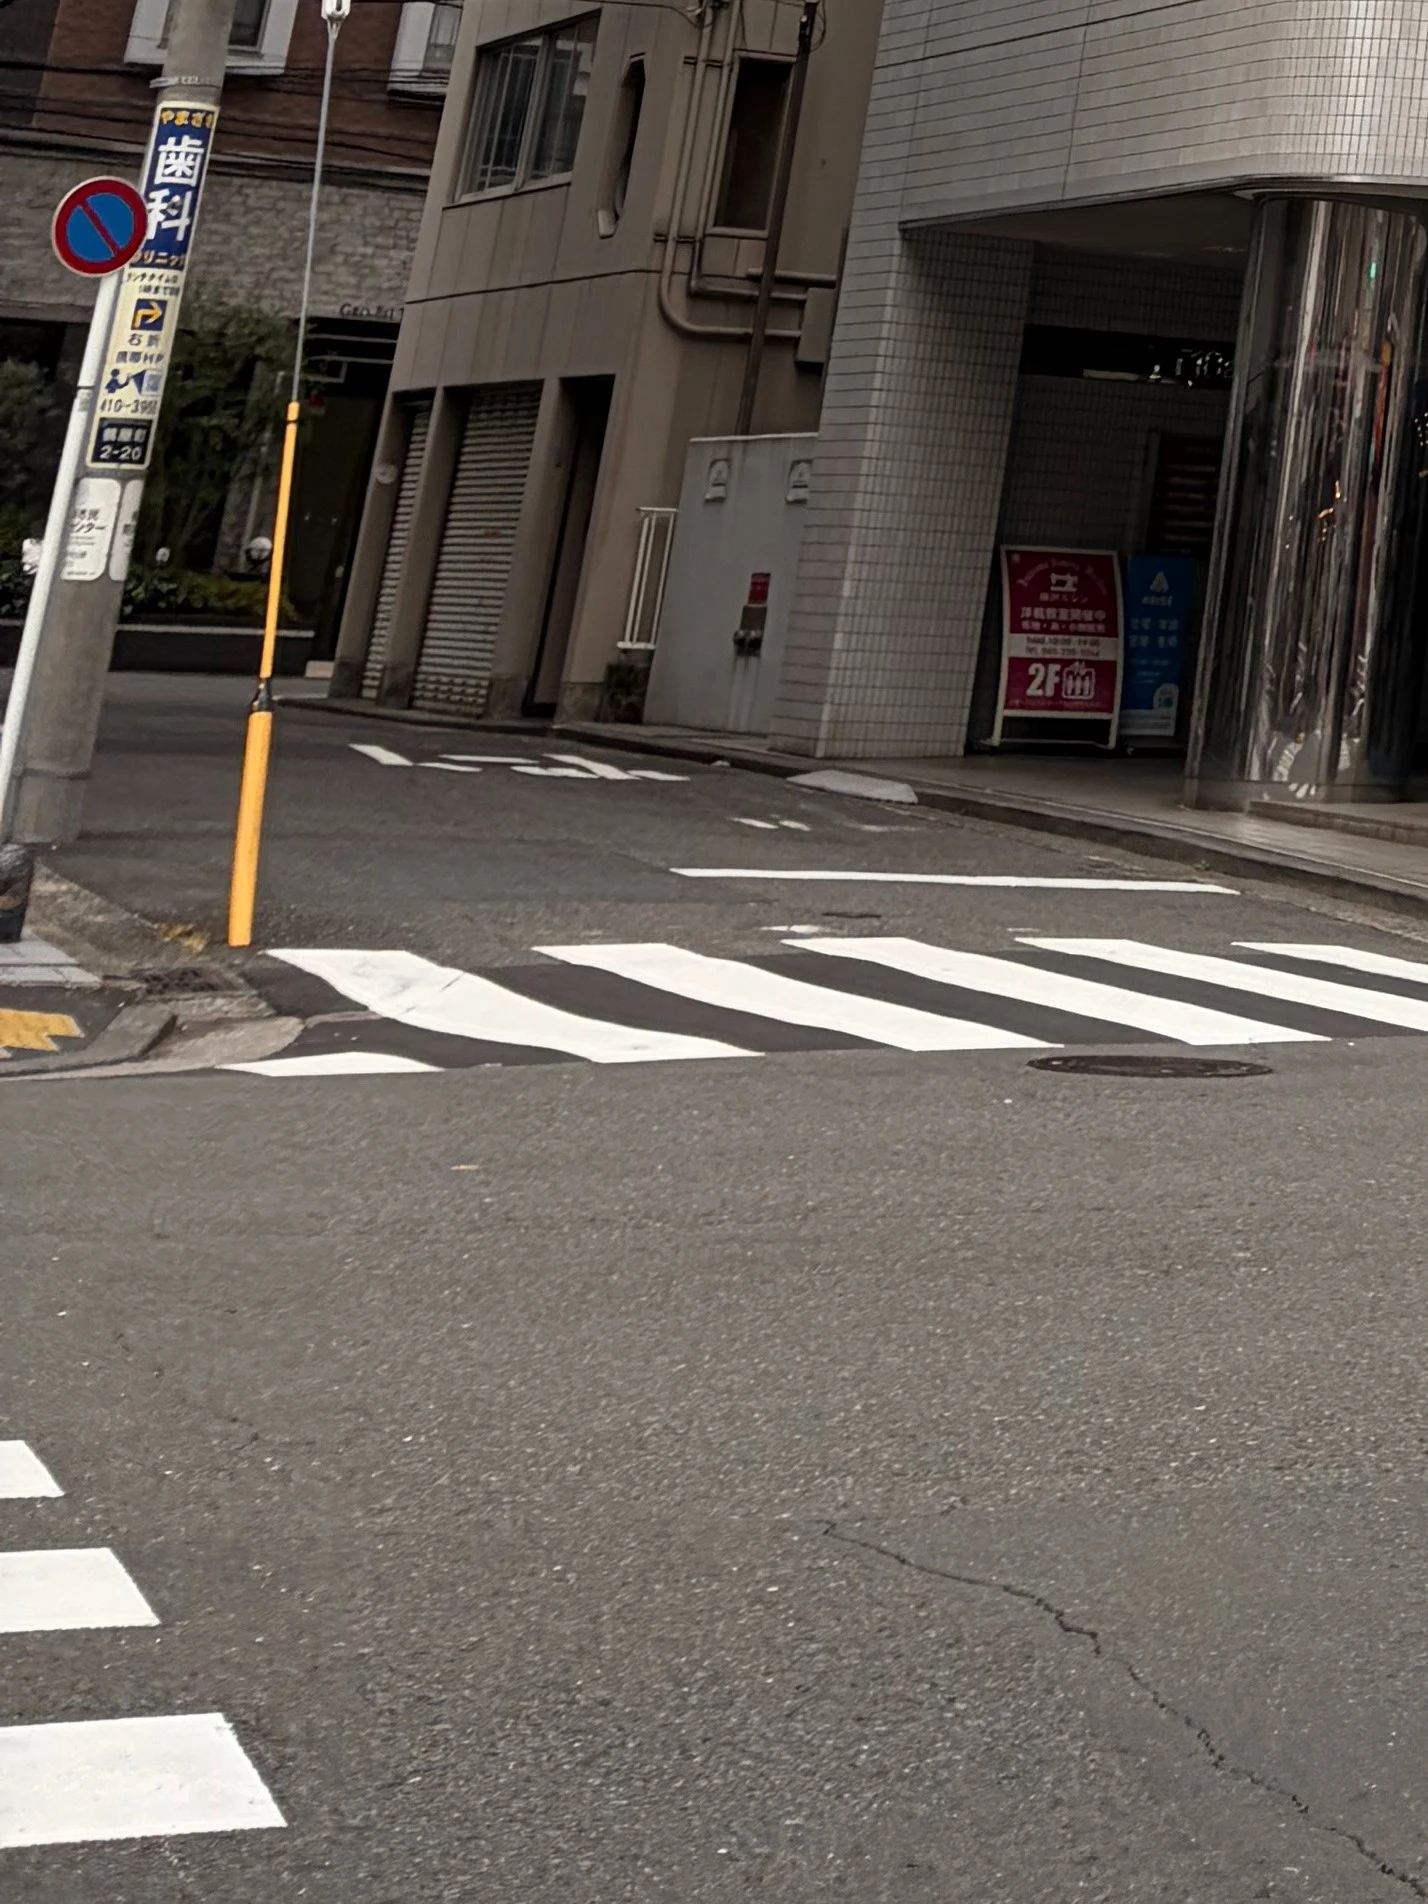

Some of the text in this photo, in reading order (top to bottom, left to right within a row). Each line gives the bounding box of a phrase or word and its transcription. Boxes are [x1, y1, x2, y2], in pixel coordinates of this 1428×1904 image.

[147, 134, 205, 242] 歯科
[100, 445, 143, 461] 2-20
[1026, 662, 1062, 698] 2F
